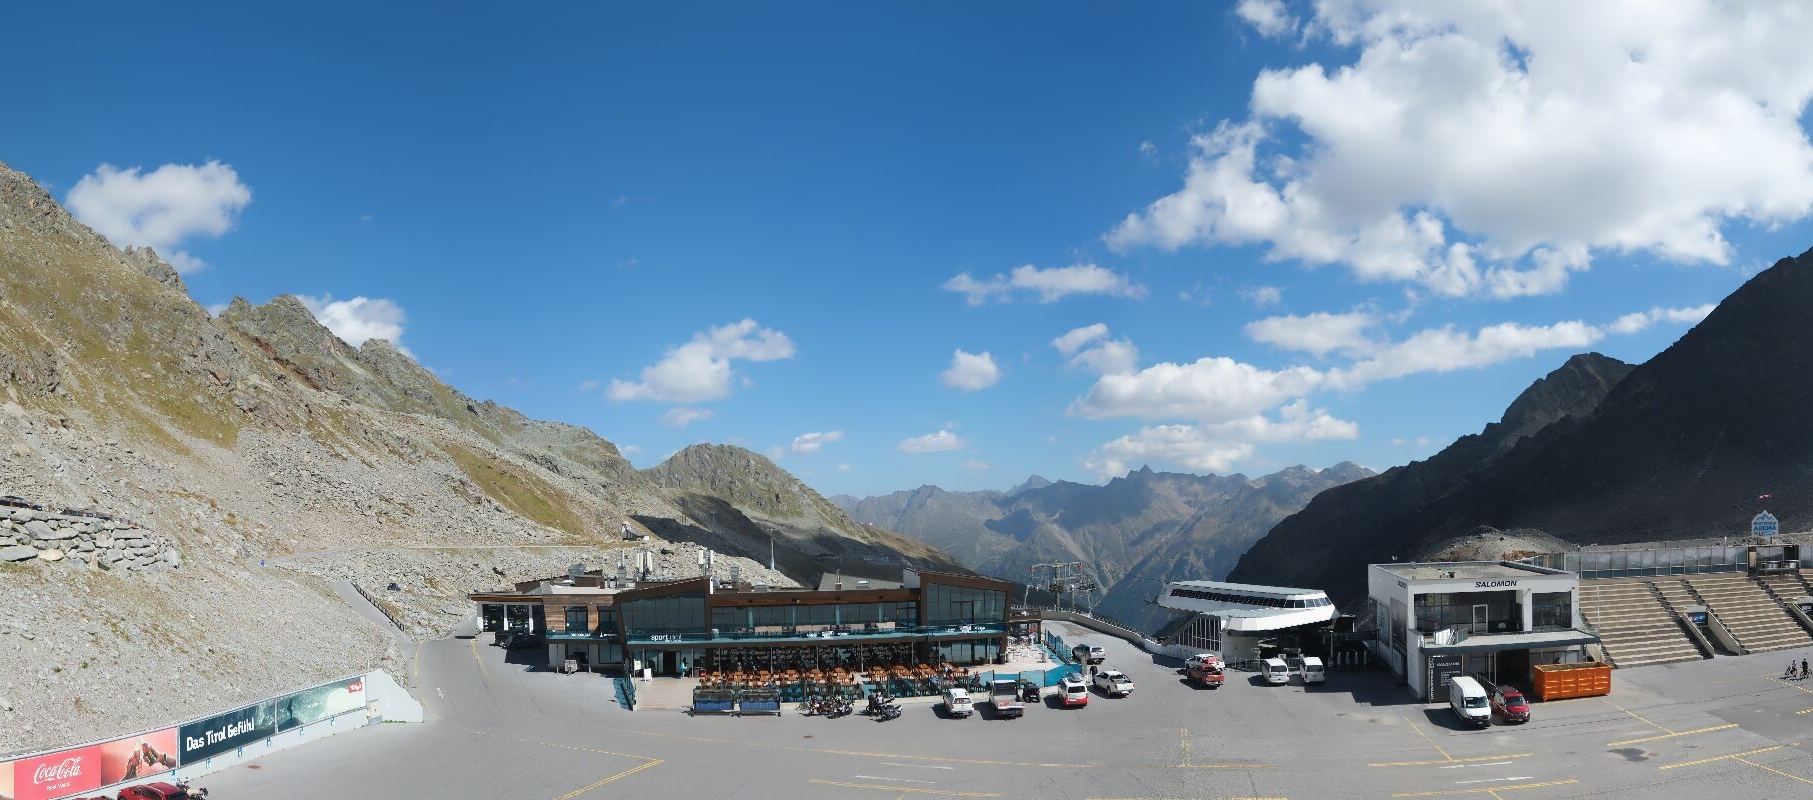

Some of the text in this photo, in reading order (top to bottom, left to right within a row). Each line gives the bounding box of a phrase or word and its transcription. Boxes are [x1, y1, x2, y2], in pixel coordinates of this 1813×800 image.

[1475, 580, 1517, 588] SALOMON
[650, 634, 669, 642] sport
[186, 717, 255, 752] Das Tirol Gefühl
